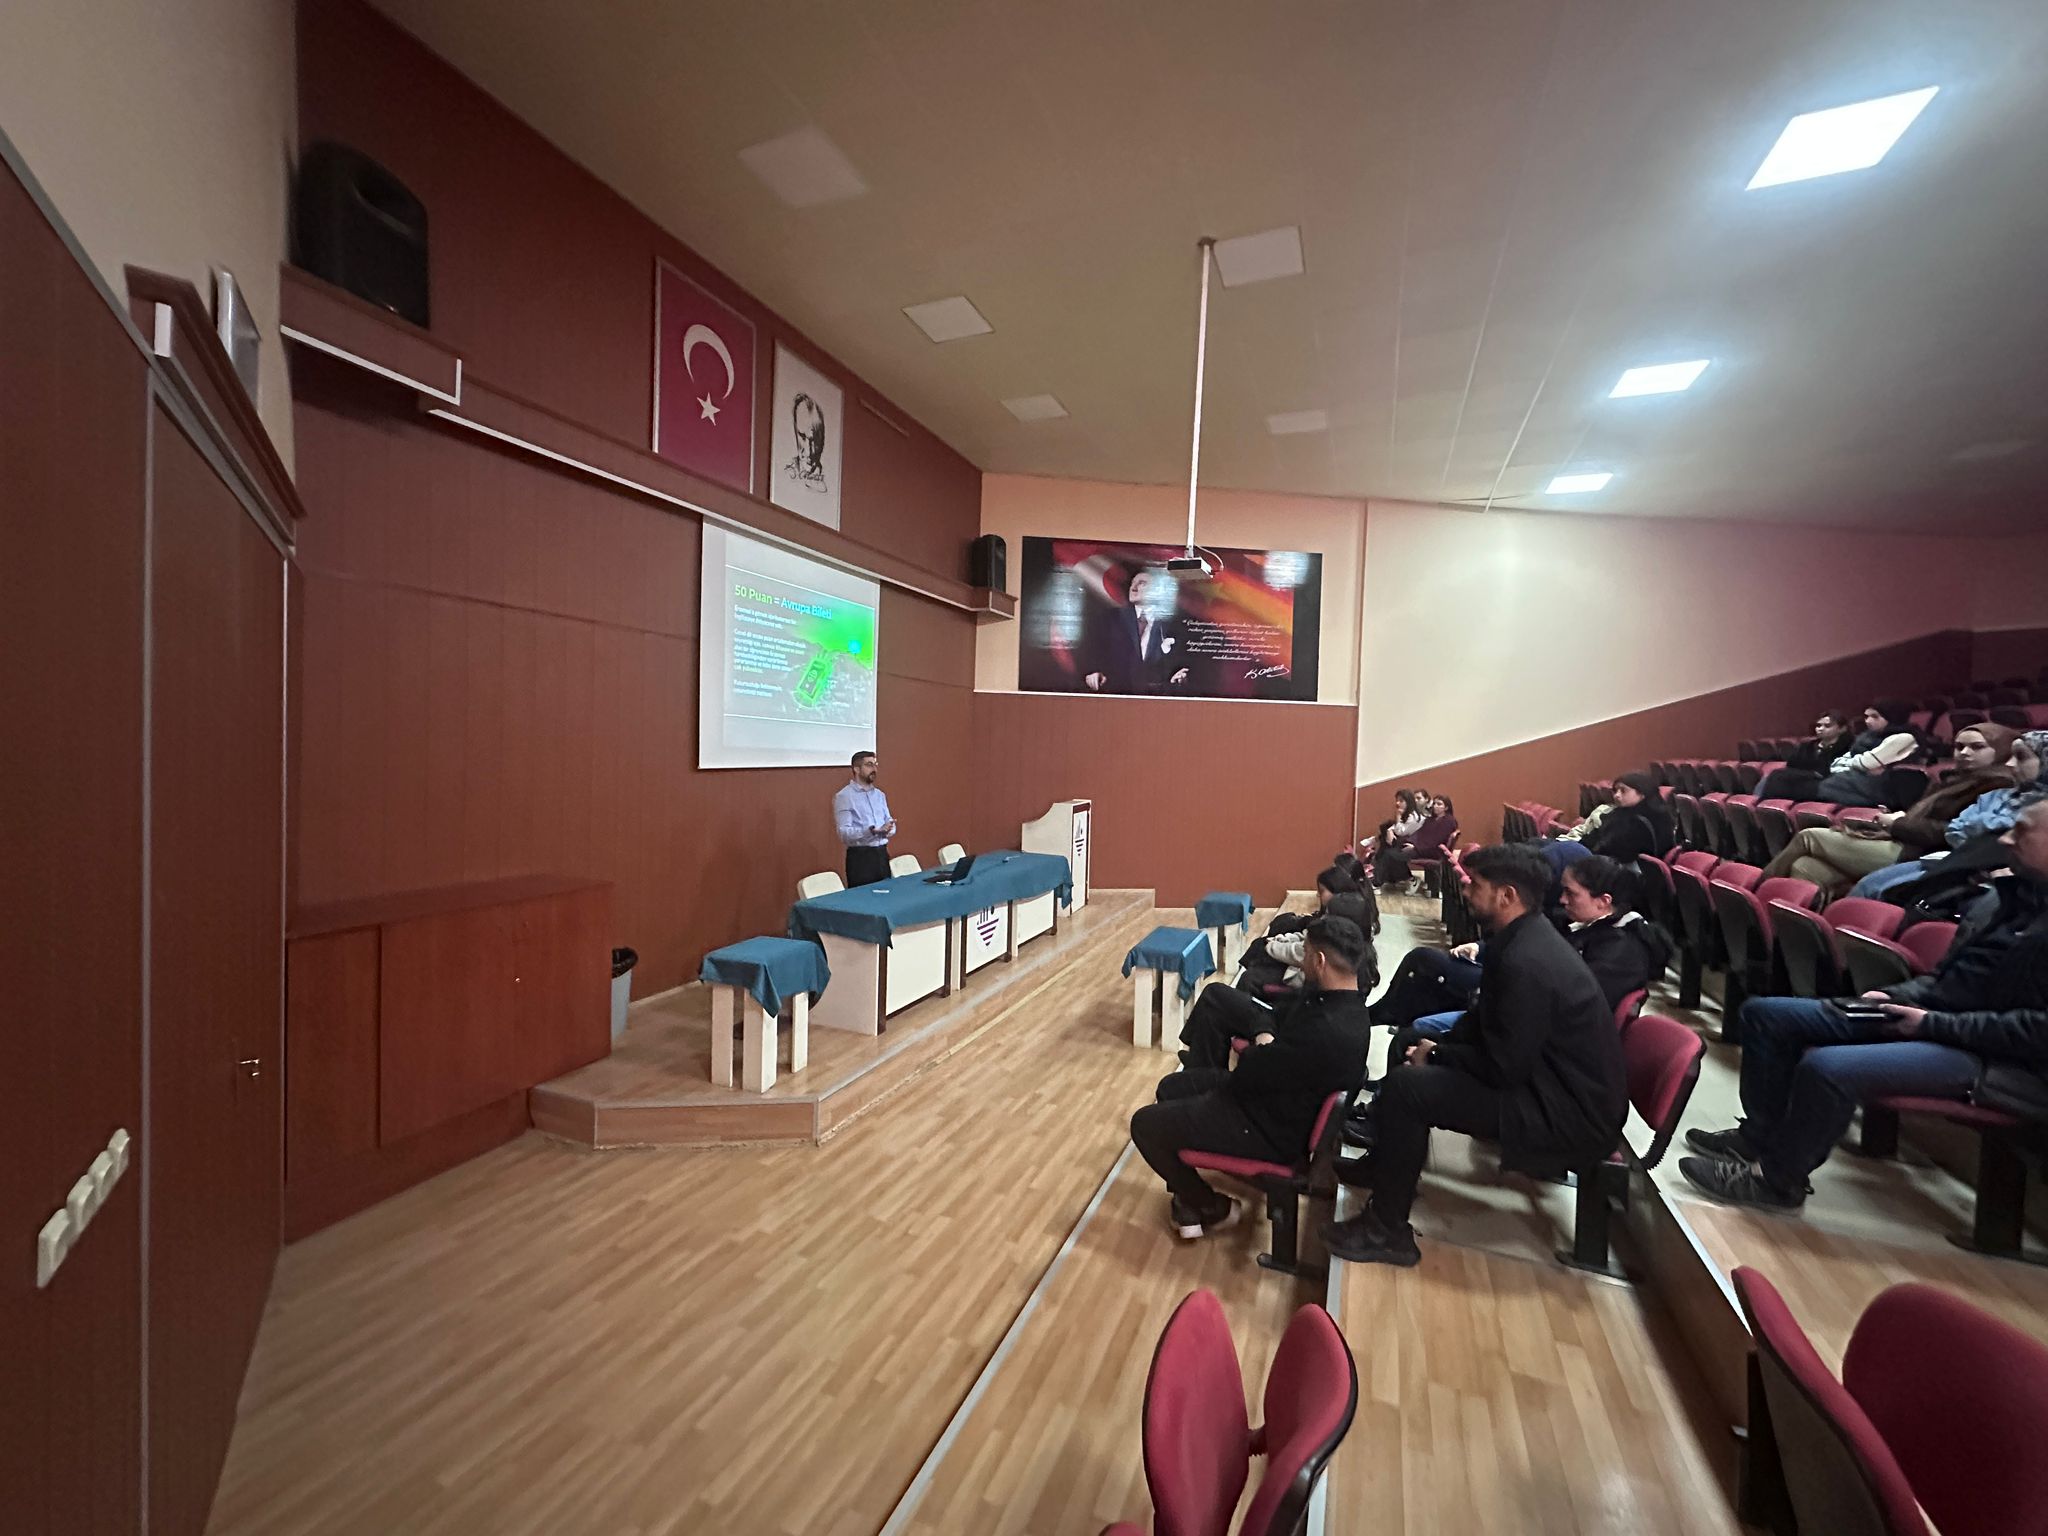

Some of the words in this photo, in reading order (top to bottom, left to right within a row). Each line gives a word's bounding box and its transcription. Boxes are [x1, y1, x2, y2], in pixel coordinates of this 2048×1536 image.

[735, 584, 747, 597] 50
[748, 588, 773, 605] Puan
[780, 597, 812, 615] Avrupa
